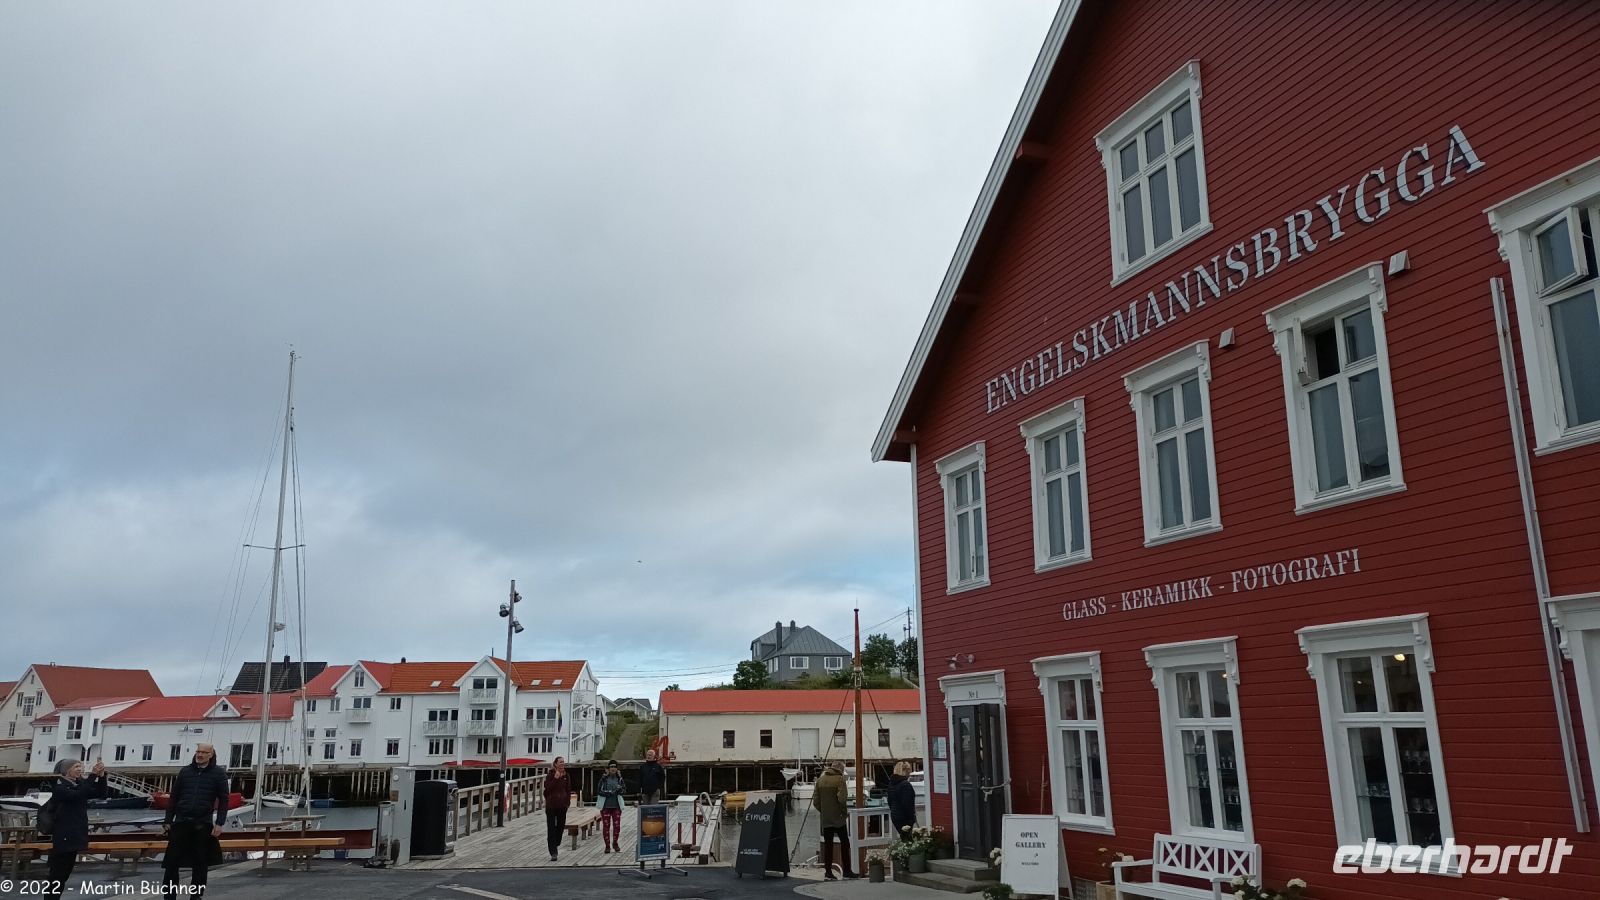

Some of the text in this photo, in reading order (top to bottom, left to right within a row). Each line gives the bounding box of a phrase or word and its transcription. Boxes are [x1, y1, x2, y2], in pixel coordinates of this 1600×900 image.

[985, 124, 1486, 414] ENGELSKMANNSBRYGGA
[1062, 596, 1107, 621] GLASS
[1121, 576, 1214, 612] KERAMIKK
[1231, 548, 1362, 593] FOTOGRAFI
